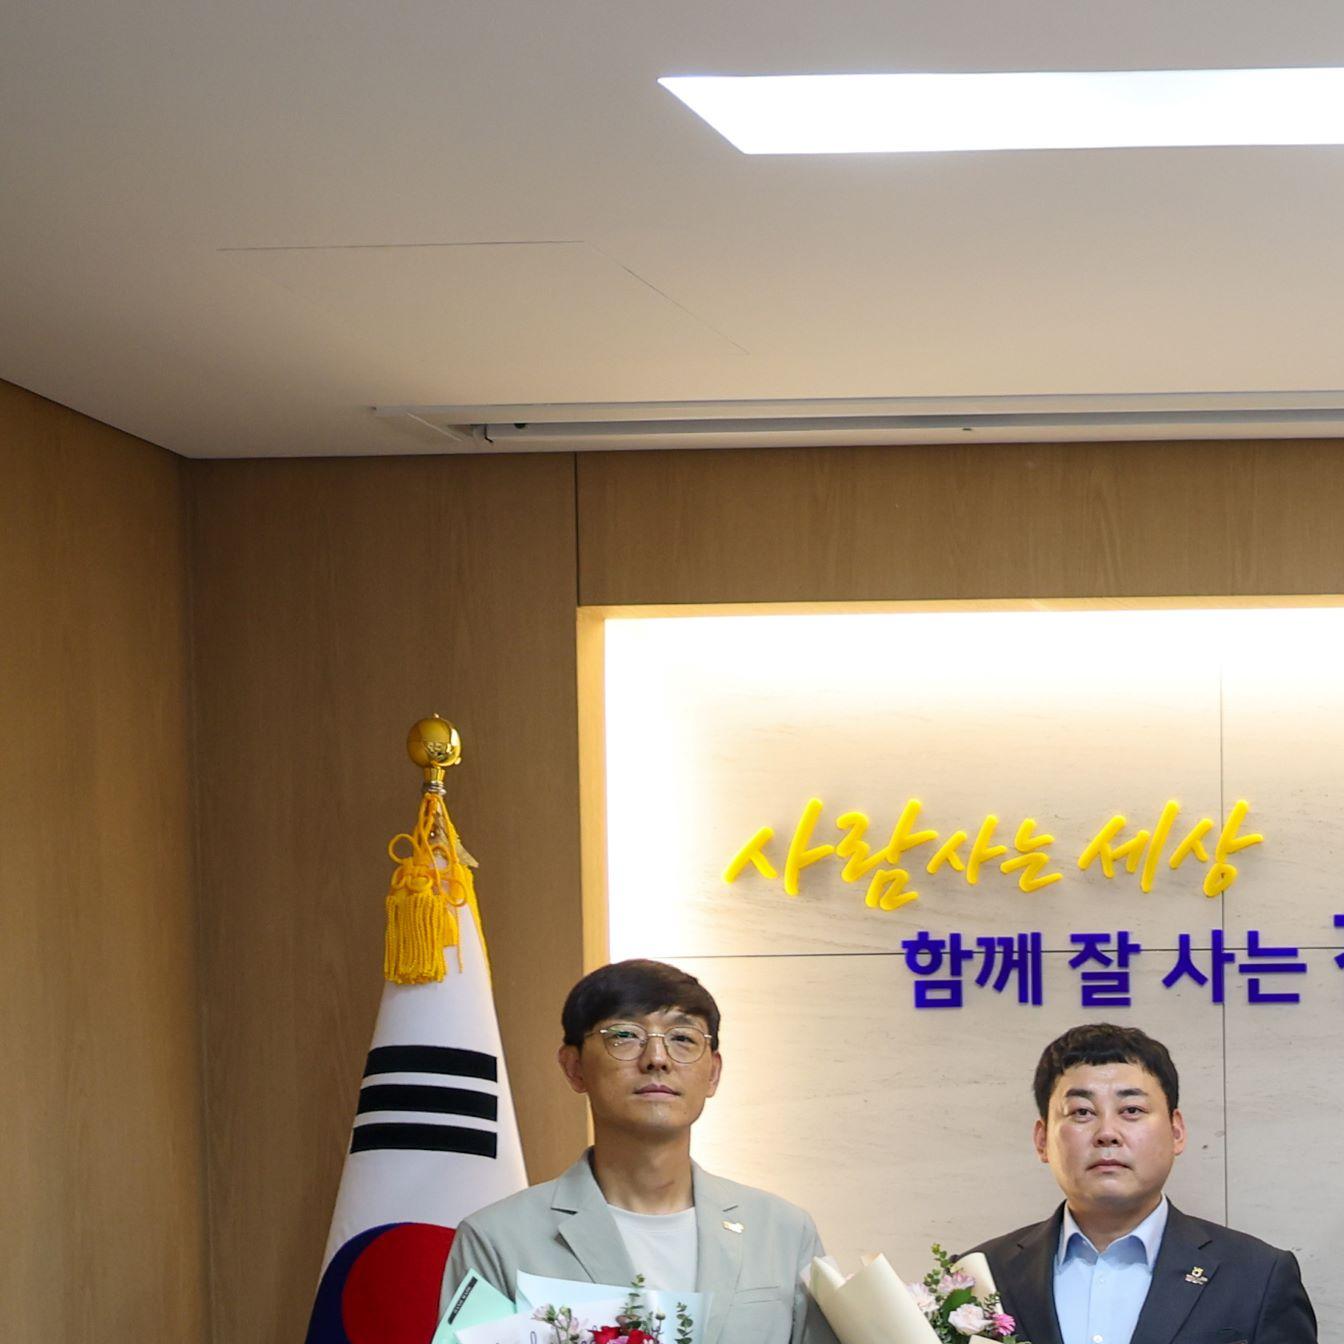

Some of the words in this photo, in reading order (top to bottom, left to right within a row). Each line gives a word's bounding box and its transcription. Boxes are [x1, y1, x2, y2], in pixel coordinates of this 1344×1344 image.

[1078, 802, 1263, 897] 세상
[902, 932, 1042, 1008] 함께
[1069, 932, 1141, 1006] 잘
[1163, 930, 1306, 1003] 사는
